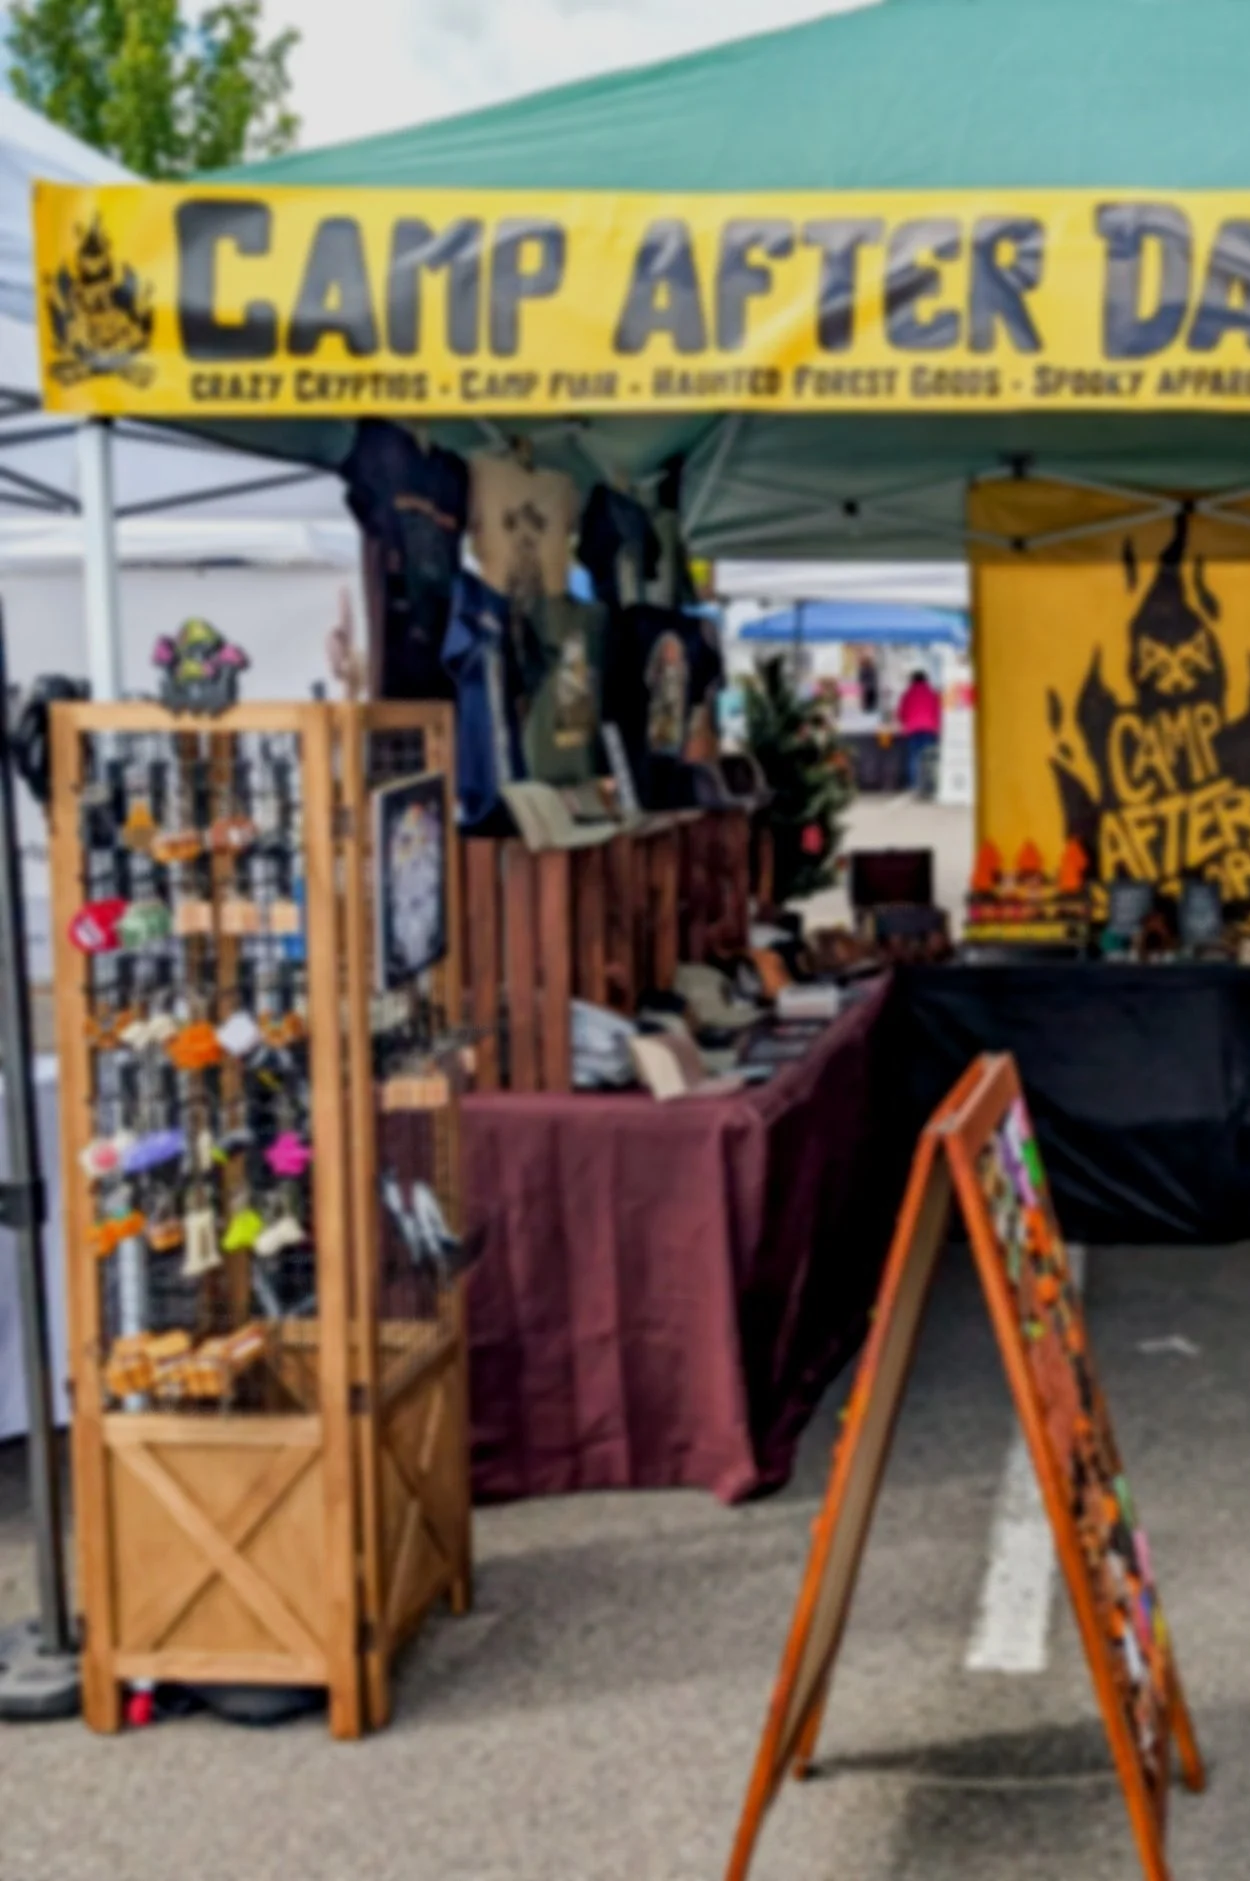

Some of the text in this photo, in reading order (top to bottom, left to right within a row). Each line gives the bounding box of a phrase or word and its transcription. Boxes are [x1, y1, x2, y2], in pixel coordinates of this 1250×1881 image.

[174, 197, 567, 361] CAMP
[612, 215, 1044, 356] AFTER
[189, 371, 284, 401] CRAZY
[293, 367, 431, 402] CRYPTIDS
[459, 367, 542, 400] CAMP
[651, 366, 784, 400] HAUNTED
[793, 366, 898, 399] FOREST
[909, 364, 1000, 399] GOODS
[1032, 363, 1145, 400] SPOOKY
[1107, 702, 1221, 807] CAMP
